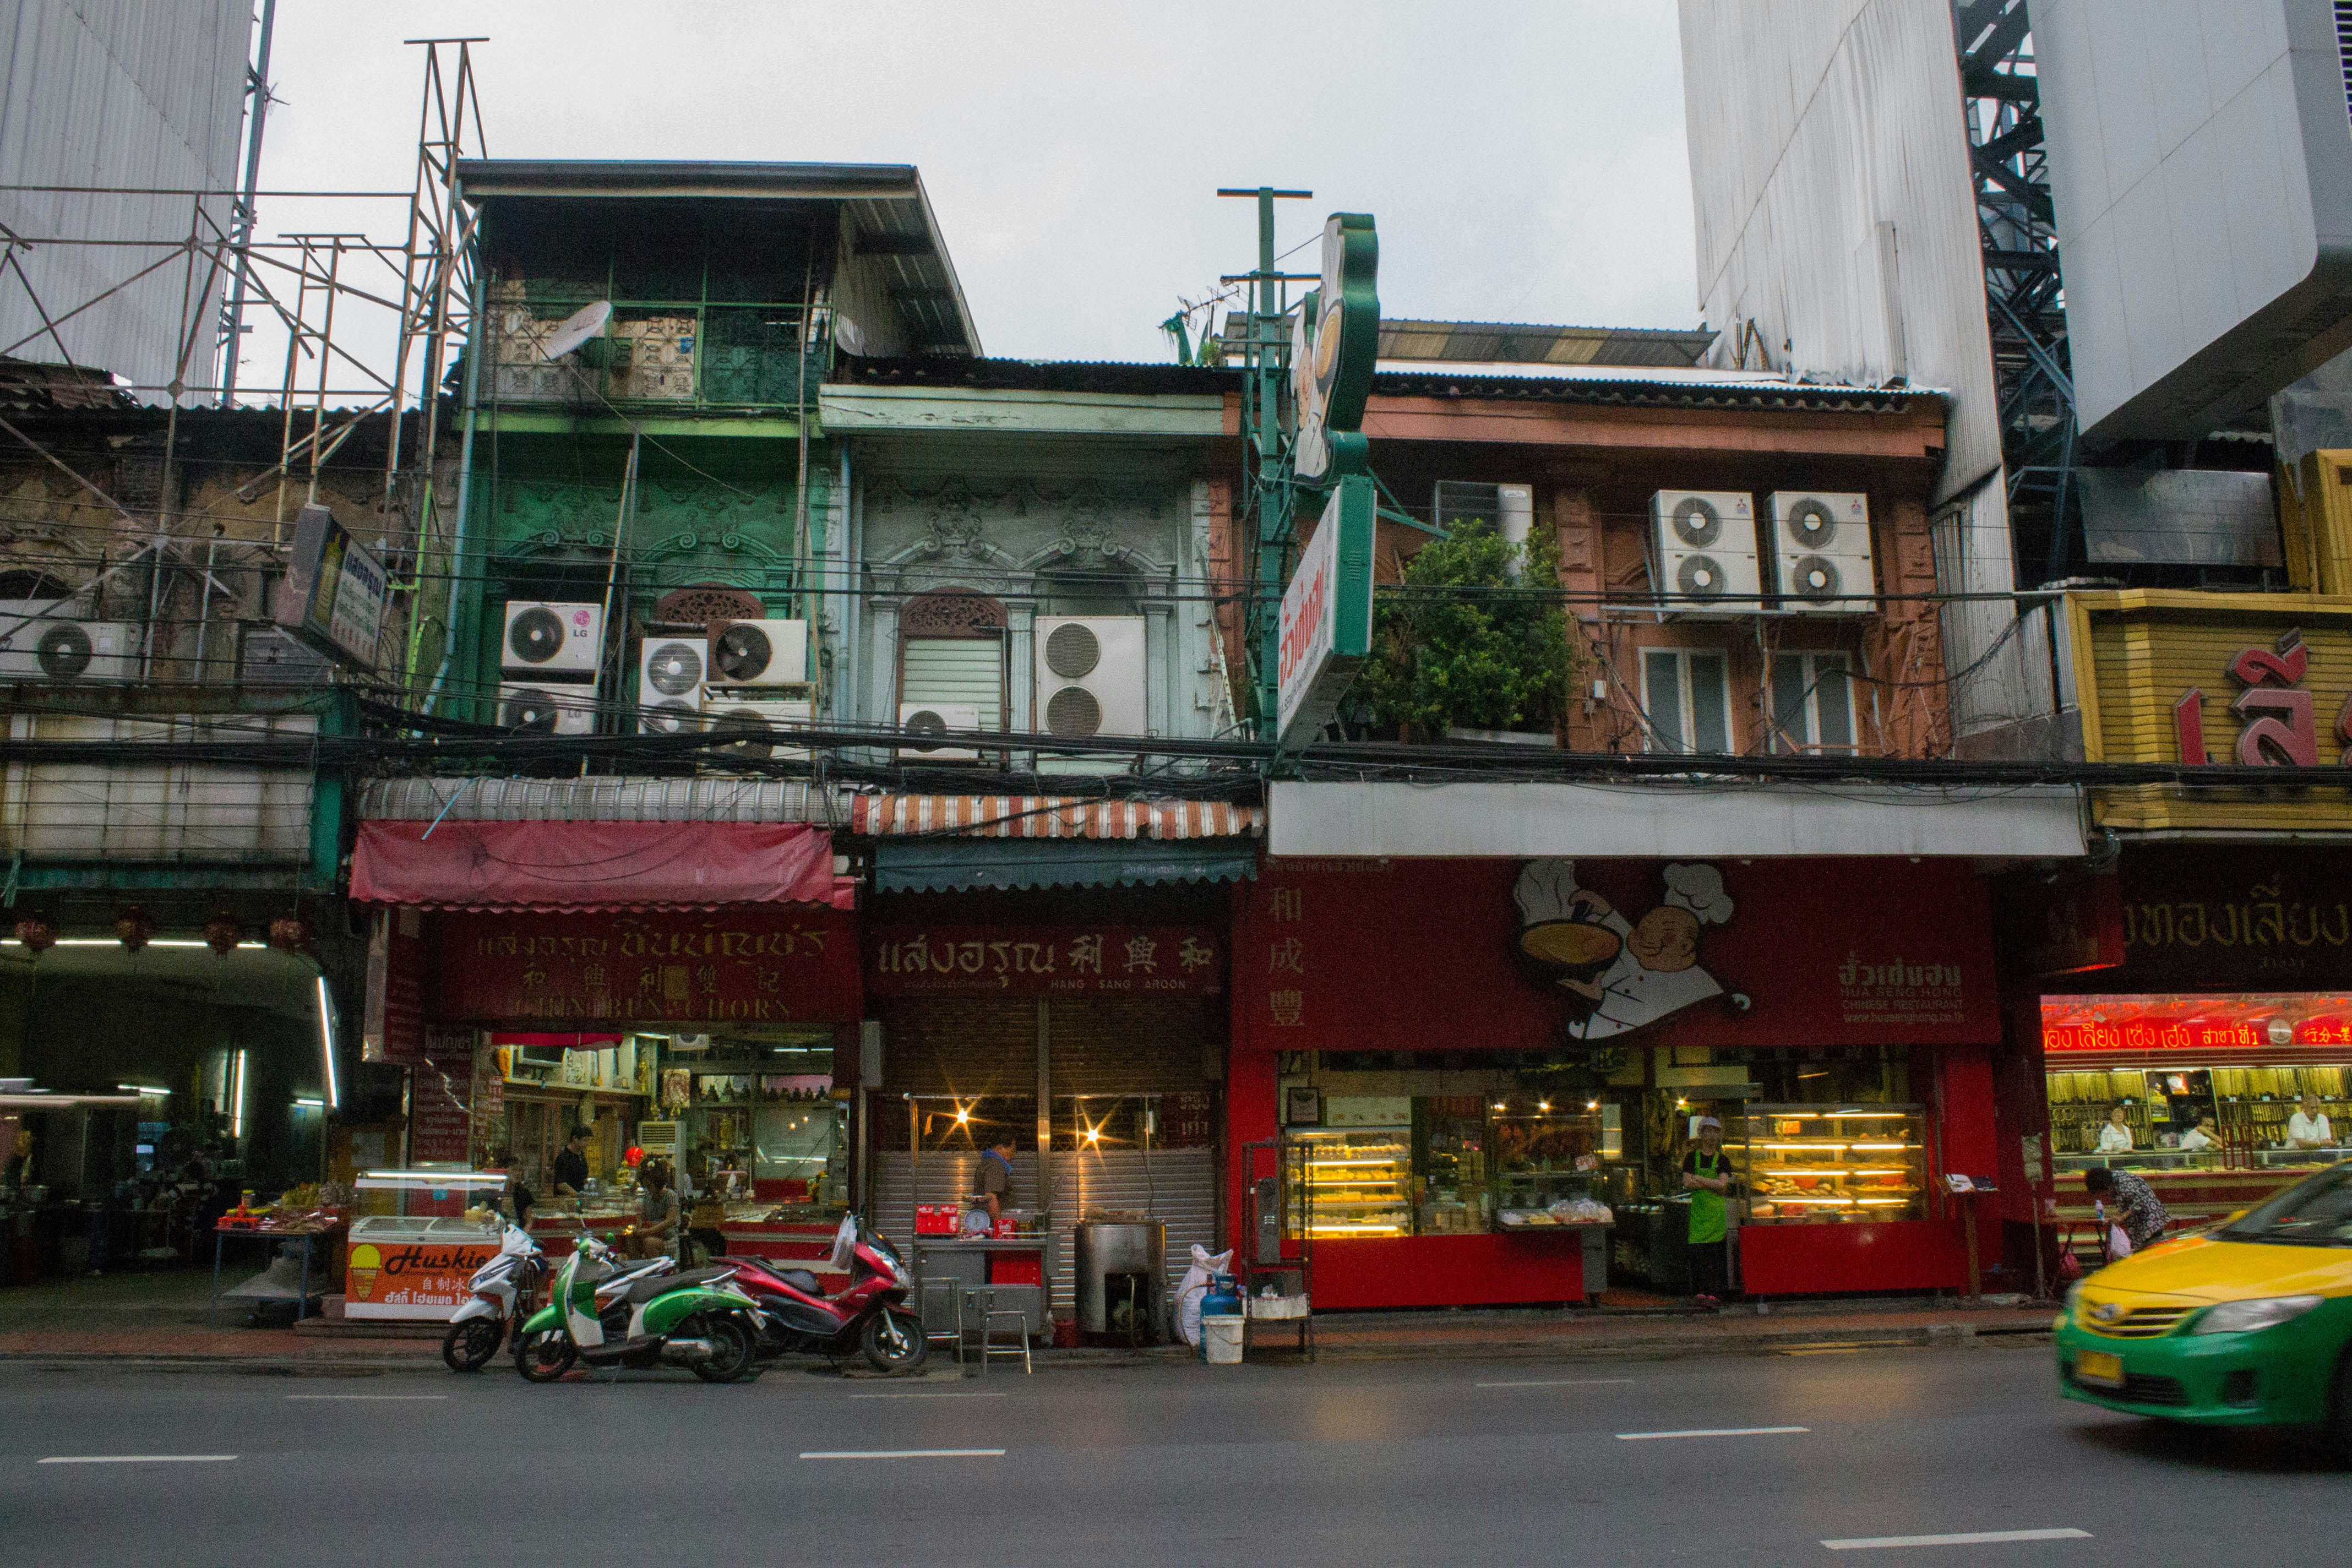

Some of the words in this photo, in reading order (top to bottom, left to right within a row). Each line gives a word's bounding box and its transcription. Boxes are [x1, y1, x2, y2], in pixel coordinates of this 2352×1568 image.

[573, 629, 588, 638] LG
[879, 934, 1056, 988] แสงอรุณ
[1049, 979, 1085, 989] HANG
[1098, 979, 1131, 989] SANG
[1841, 987, 1870, 997] HUA
[1875, 987, 1915, 997] SENG
[1921, 987, 1964, 997] HONG
[456, 1292, 475, 1305] ไอ
